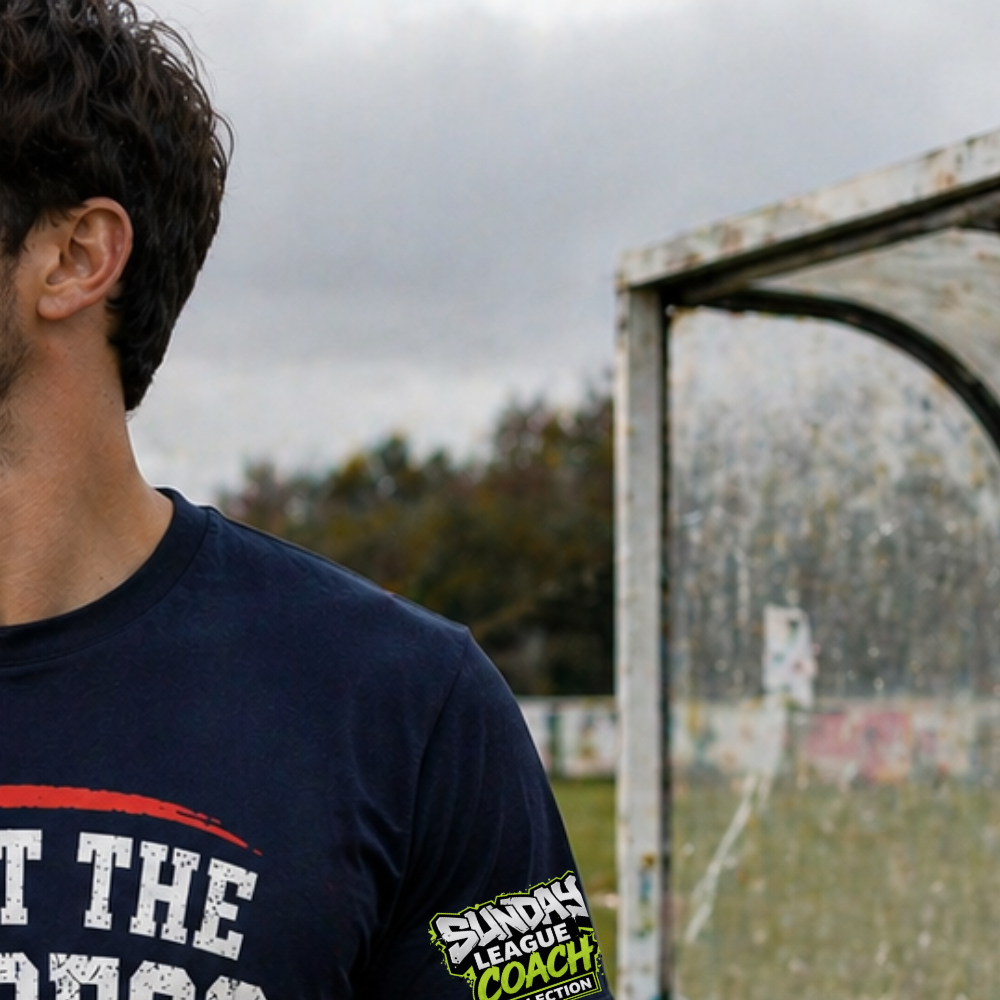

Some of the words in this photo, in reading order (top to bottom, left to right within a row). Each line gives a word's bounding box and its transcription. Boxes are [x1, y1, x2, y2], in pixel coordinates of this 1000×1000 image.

[77, 831, 258, 960] THE
[435, 875, 589, 964] SUNDAY
[474, 923, 571, 970] LEAGUE
